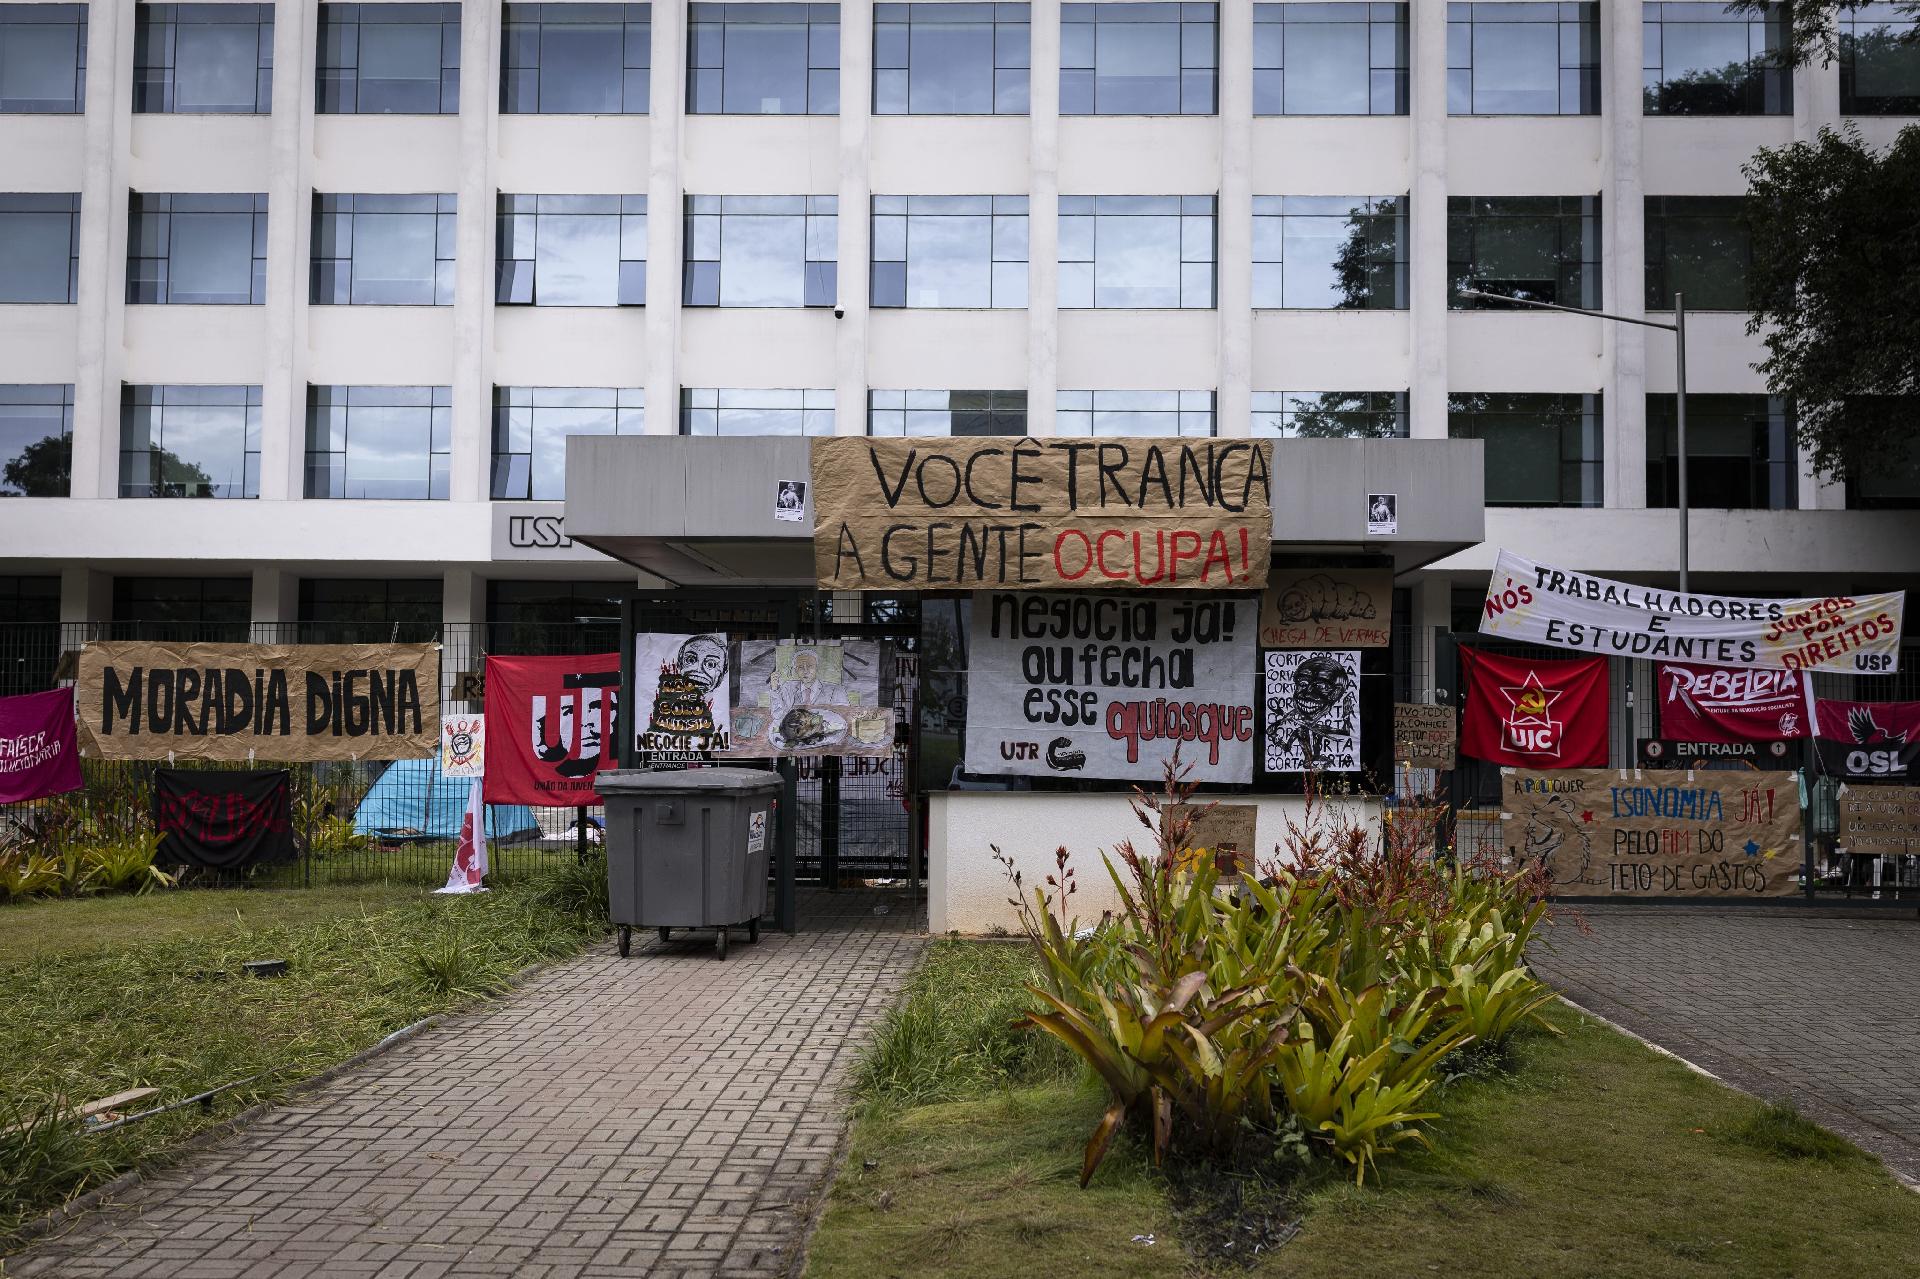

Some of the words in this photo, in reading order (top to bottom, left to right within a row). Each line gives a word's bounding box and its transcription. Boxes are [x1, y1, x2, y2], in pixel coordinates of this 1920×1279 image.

[870, 438, 1043, 511] VOCÊ
[1051, 443, 1271, 512] TRANCA
[834, 521, 865, 580] A
[881, 521, 1044, 584] GENTE
[1054, 527, 1249, 585] OCUPA!
[1485, 577, 1533, 620] NÓS
[1534, 566, 1783, 621] TRABALHADORES
[1765, 596, 1856, 642] JUNTOS
[1263, 627, 1307, 644] CHEGA
[1314, 626, 1336, 643] DE
[1339, 627, 1389, 645] VERMES
[1647, 615, 1671, 633] E
[1803, 615, 1845, 641] POR
[1545, 620, 1756, 662] ESTUDANTES
[1781, 613, 1894, 670] DIREITOS
[1022, 645, 1074, 685] ou
[1079, 643, 1195, 689] fecha
[1855, 655, 1892, 671] USP
[1268, 682, 1297, 694] CORT
[1662, 665, 1798, 716] REBELDIA
[636, 733, 692, 751] NEGOCIE
[697, 724, 730, 750] JÁ!
[1023, 687, 1098, 726] esse
[1106, 698, 1253, 765] quiosque
[1000, 741, 1040, 760] UJR
[1510, 727, 1552, 752] UJC
[1676, 743, 1756, 756] ENTRADA
[651, 752, 704, 761] ENTRADA
[1846, 750, 1908, 773] OSL
[569, 780, 594, 791] JUVEN
[1514, 780, 1523, 795] A
[1610, 786, 1723, 822] ISONOMIA
[1734, 784, 1776, 825] JÁ!
[1614, 829, 1659, 856] PELO
[1698, 829, 1723, 854] DO
[1608, 863, 1657, 891] TETO
[1663, 864, 1686, 891] DE
